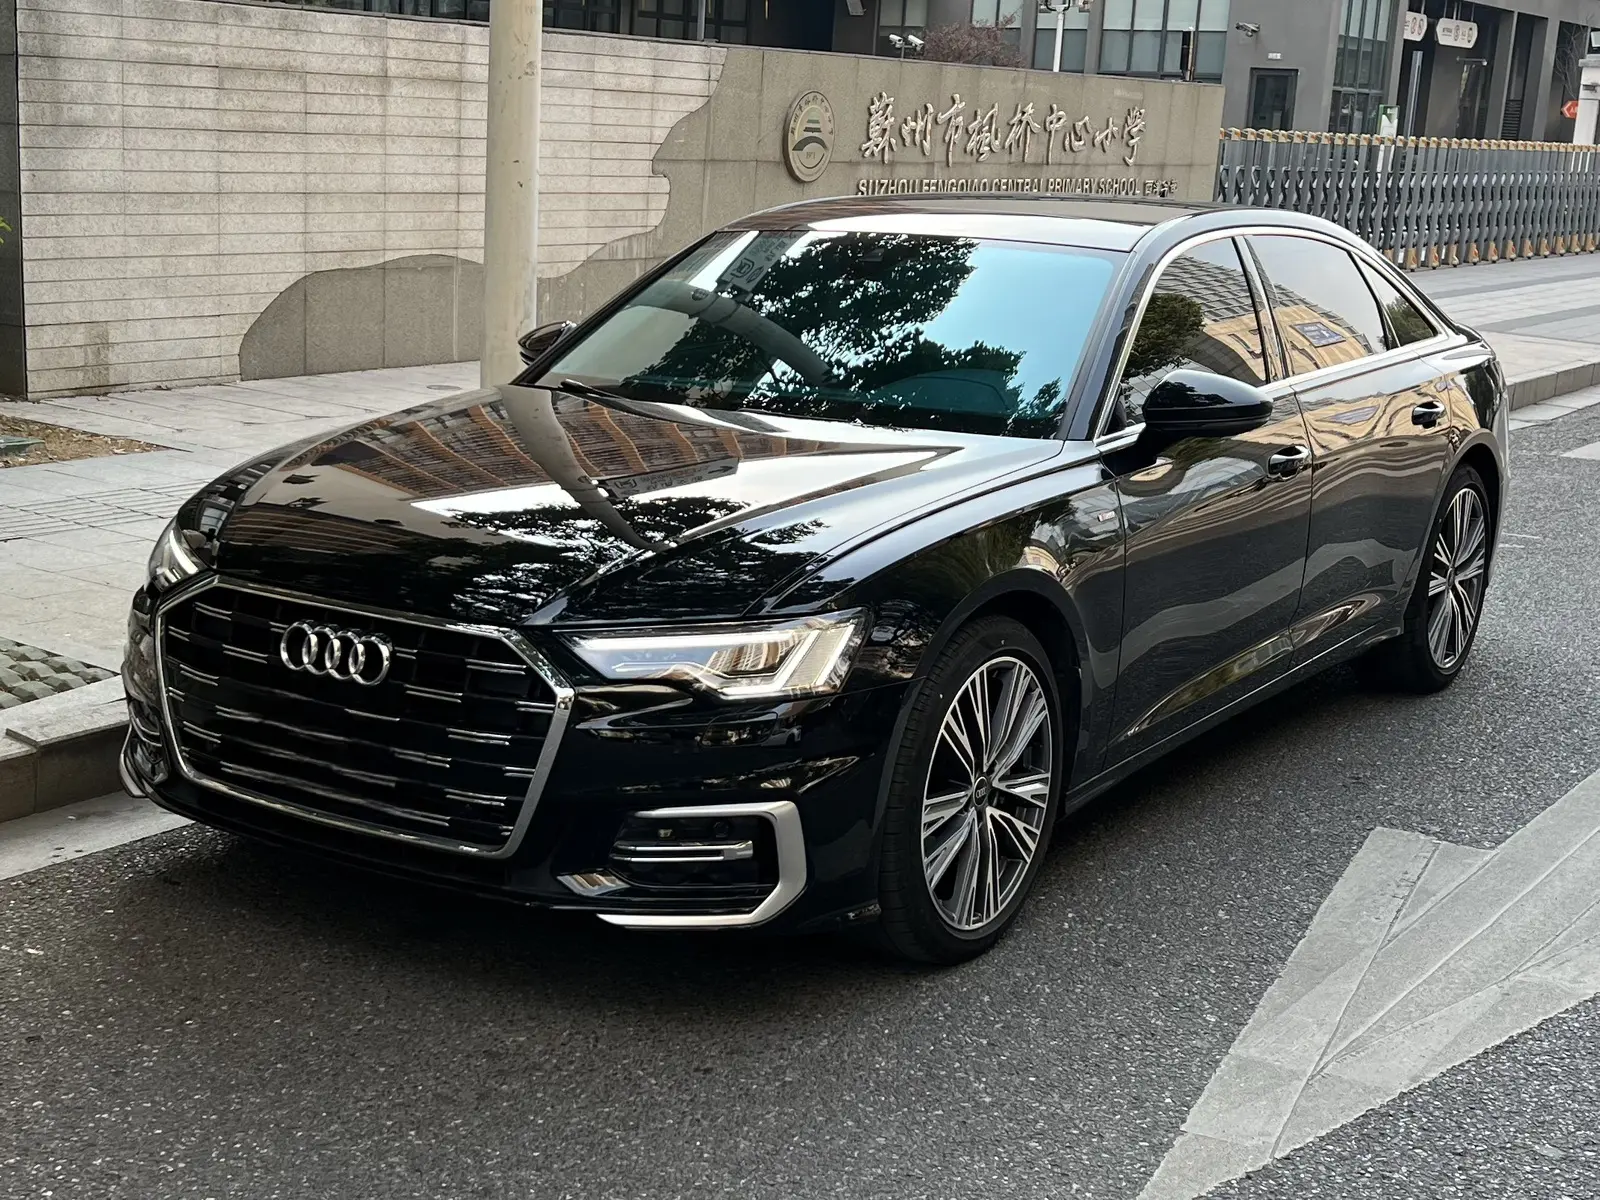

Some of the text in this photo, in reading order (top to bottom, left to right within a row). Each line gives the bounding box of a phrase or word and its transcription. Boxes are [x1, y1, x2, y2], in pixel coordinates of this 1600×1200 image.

[857, 177, 1140, 197] SUZHOU FENGQIAO CENTRAL PRIMARY SCHOOL
